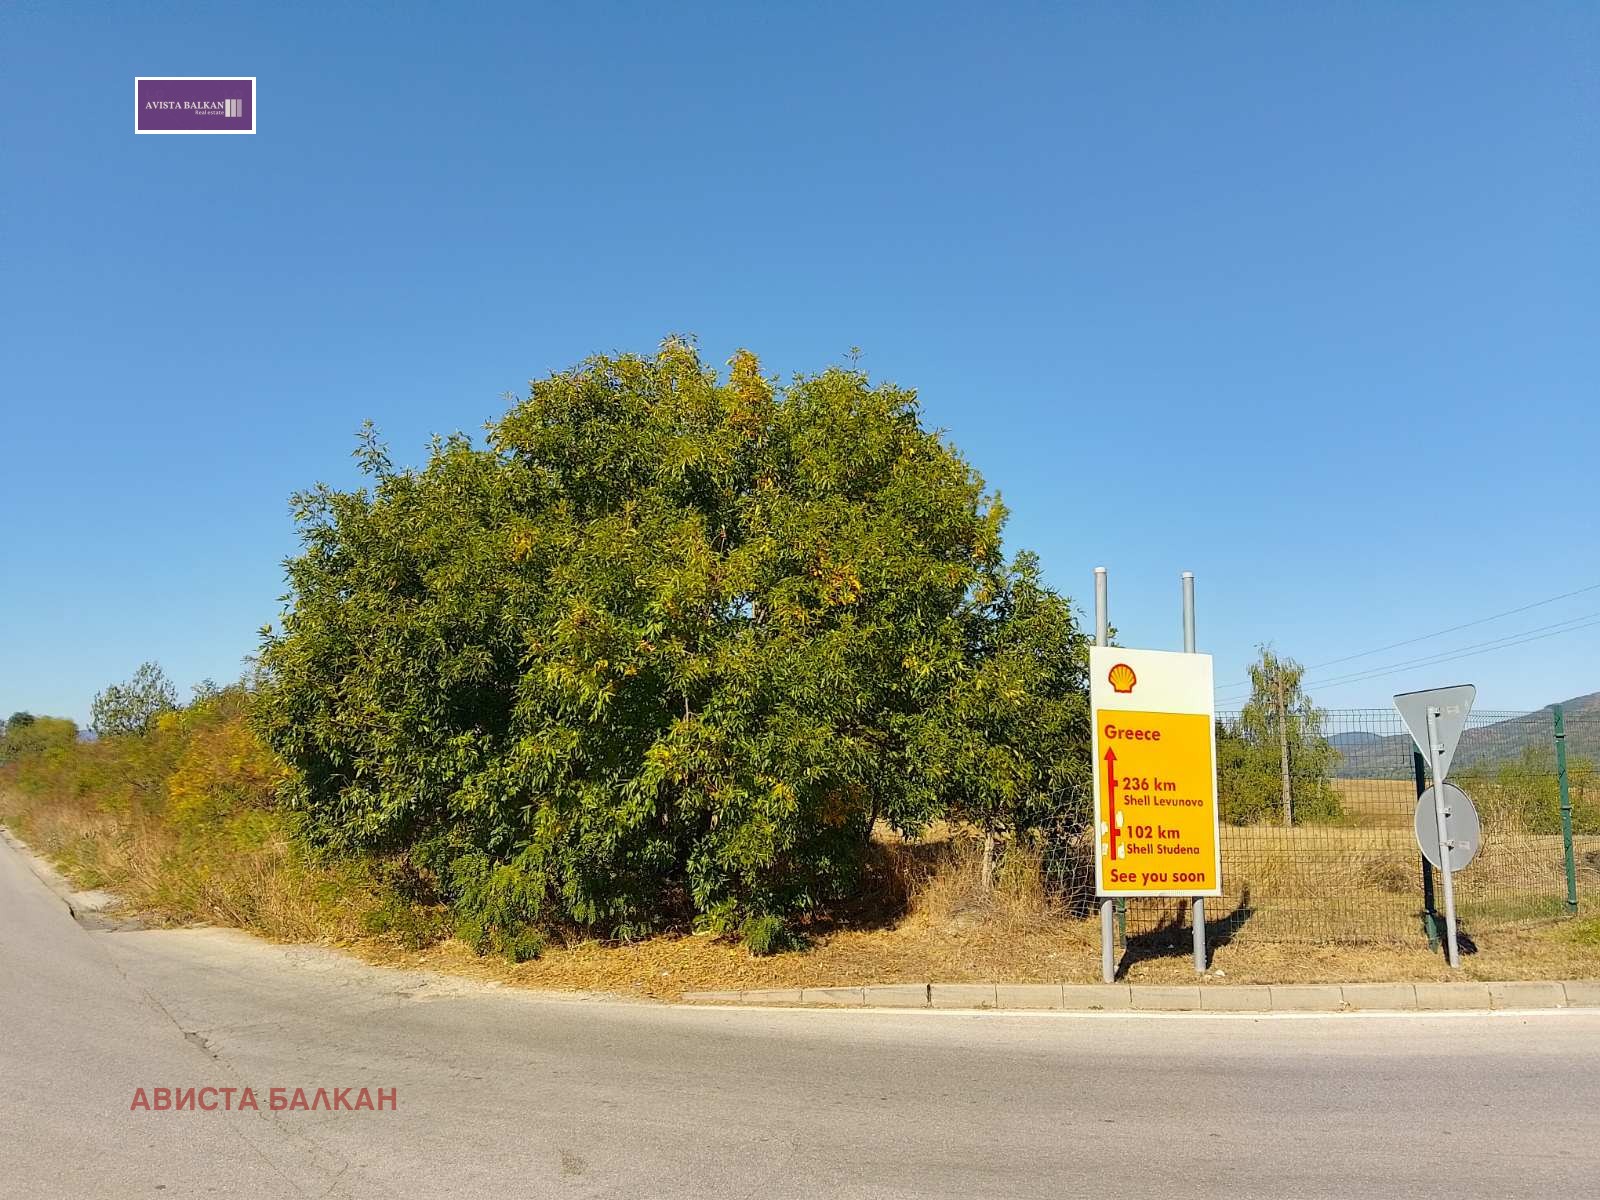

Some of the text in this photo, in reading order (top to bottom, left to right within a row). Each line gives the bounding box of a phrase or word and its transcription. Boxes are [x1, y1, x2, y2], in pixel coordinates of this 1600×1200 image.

[1104, 724, 1161, 741] Greece
[1122, 777, 1176, 791] 236 km
[1123, 794, 1204, 808] Shell Levunovo
[1127, 825, 1180, 839] 102 km
[1126, 843, 1200, 855] Shell Studena
[1110, 869, 1205, 886] See you soon
